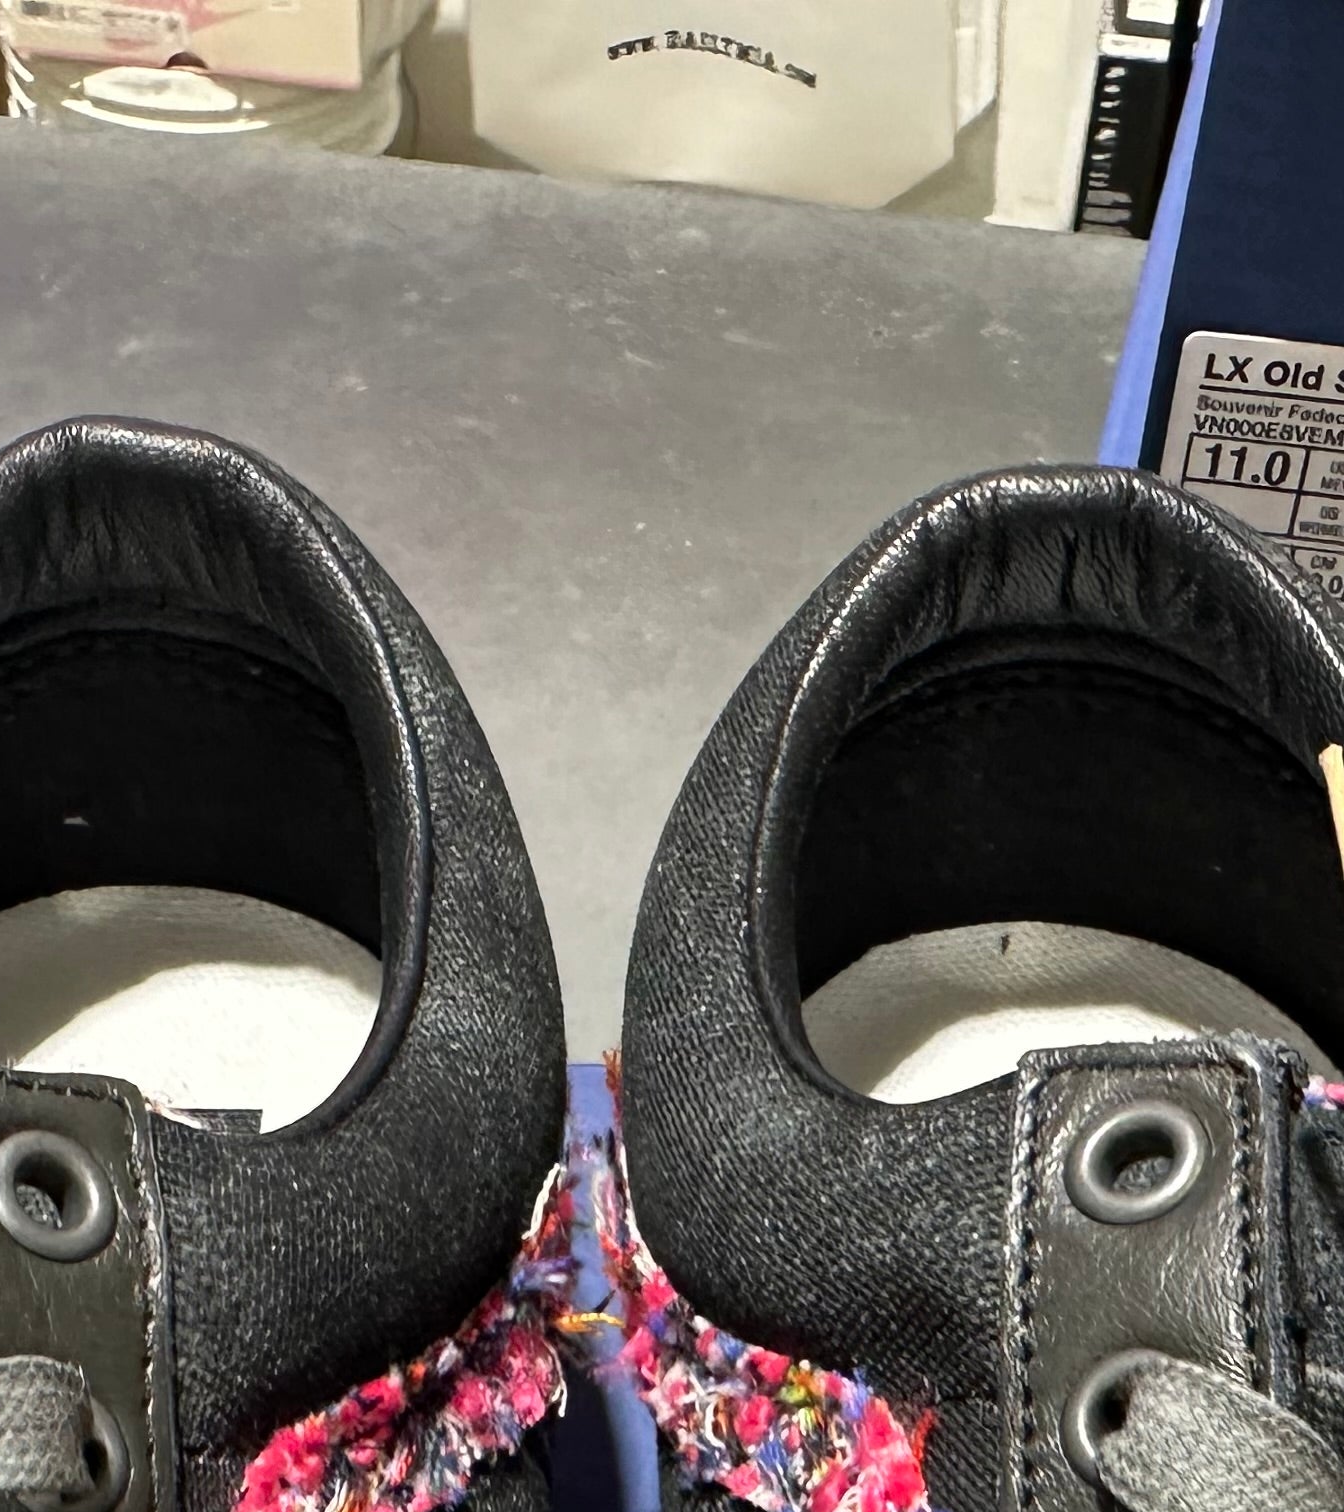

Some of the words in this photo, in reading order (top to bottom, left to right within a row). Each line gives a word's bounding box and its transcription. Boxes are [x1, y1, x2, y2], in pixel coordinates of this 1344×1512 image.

[1204, 353, 1253, 383] LX
[1263, 360, 1324, 391] Old
[1196, 394, 1283, 418] Souvenir
[1205, 443, 1291, 486] 11.0
